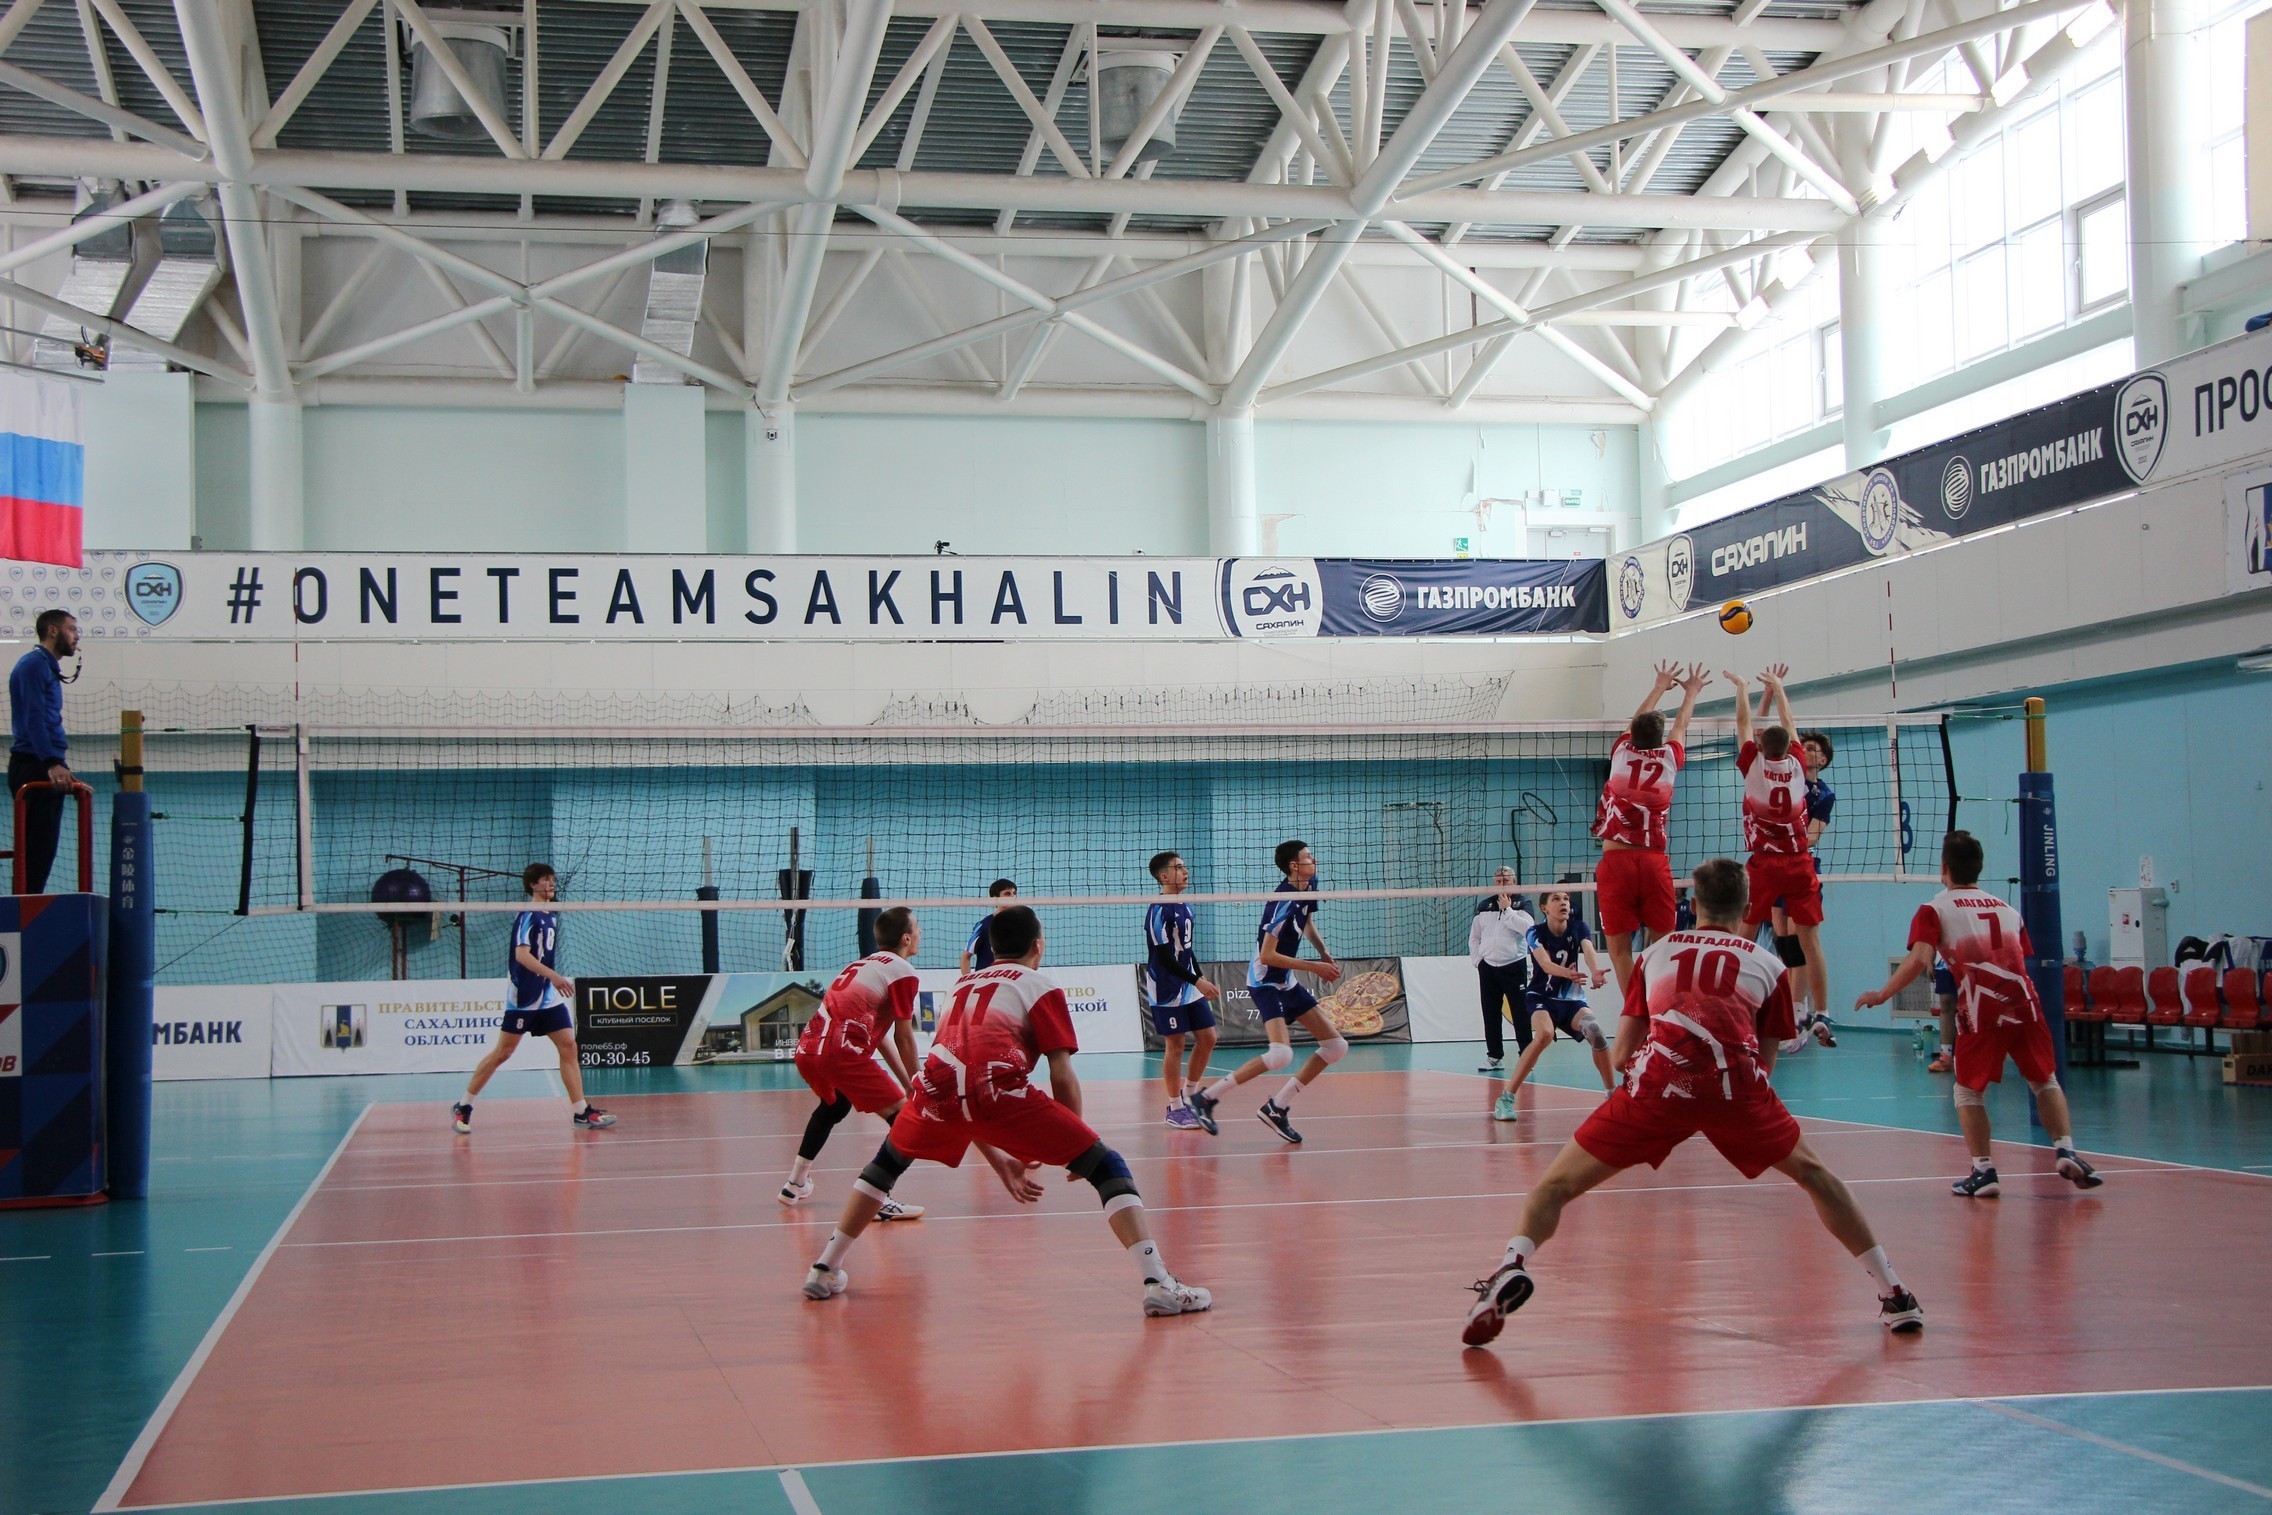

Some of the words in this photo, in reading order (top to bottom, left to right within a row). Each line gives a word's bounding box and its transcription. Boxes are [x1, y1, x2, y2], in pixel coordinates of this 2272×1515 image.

[1980, 427, 2104, 494] ГАЗПРОМБАНК
[1711, 521, 1807, 577] САХАЛИН
[227, 566, 1183, 625] #ONETEAMSAKHALIN
[1417, 585, 1576, 609] ГАЗПРОМБАНК
[1626, 759, 1664, 794] 12
[1768, 786, 1792, 818] 9
[2043, 824, 2056, 877] JINLING
[546, 927, 555, 951] 8
[1184, 919, 1192, 942] 9
[1977, 912, 2003, 950] 7
[1668, 933, 1756, 953] МАГАДАН
[831, 962, 867, 992] 5
[956, 969, 1023, 985] МАГАДАН
[1669, 947, 1741, 998] 10
[378, 1000, 505, 1014] ПРАВИТЕЛЬСТ
[947, 982, 1000, 1026] 11
[404, 1016, 503, 1029] САХАЛИНС
[516, 1018, 524, 1029] 8
[597, 1016, 634, 1024] КЛУБНЫЙ
[1169, 1017, 1177, 1029] 9
[152, 1021, 242, 1045] МБАНК
[404, 1033, 486, 1046] ОБЛАСТИ
[581, 1042, 628, 1054] поле65.рф
[581, 1051, 651, 1066] 30-30-45
